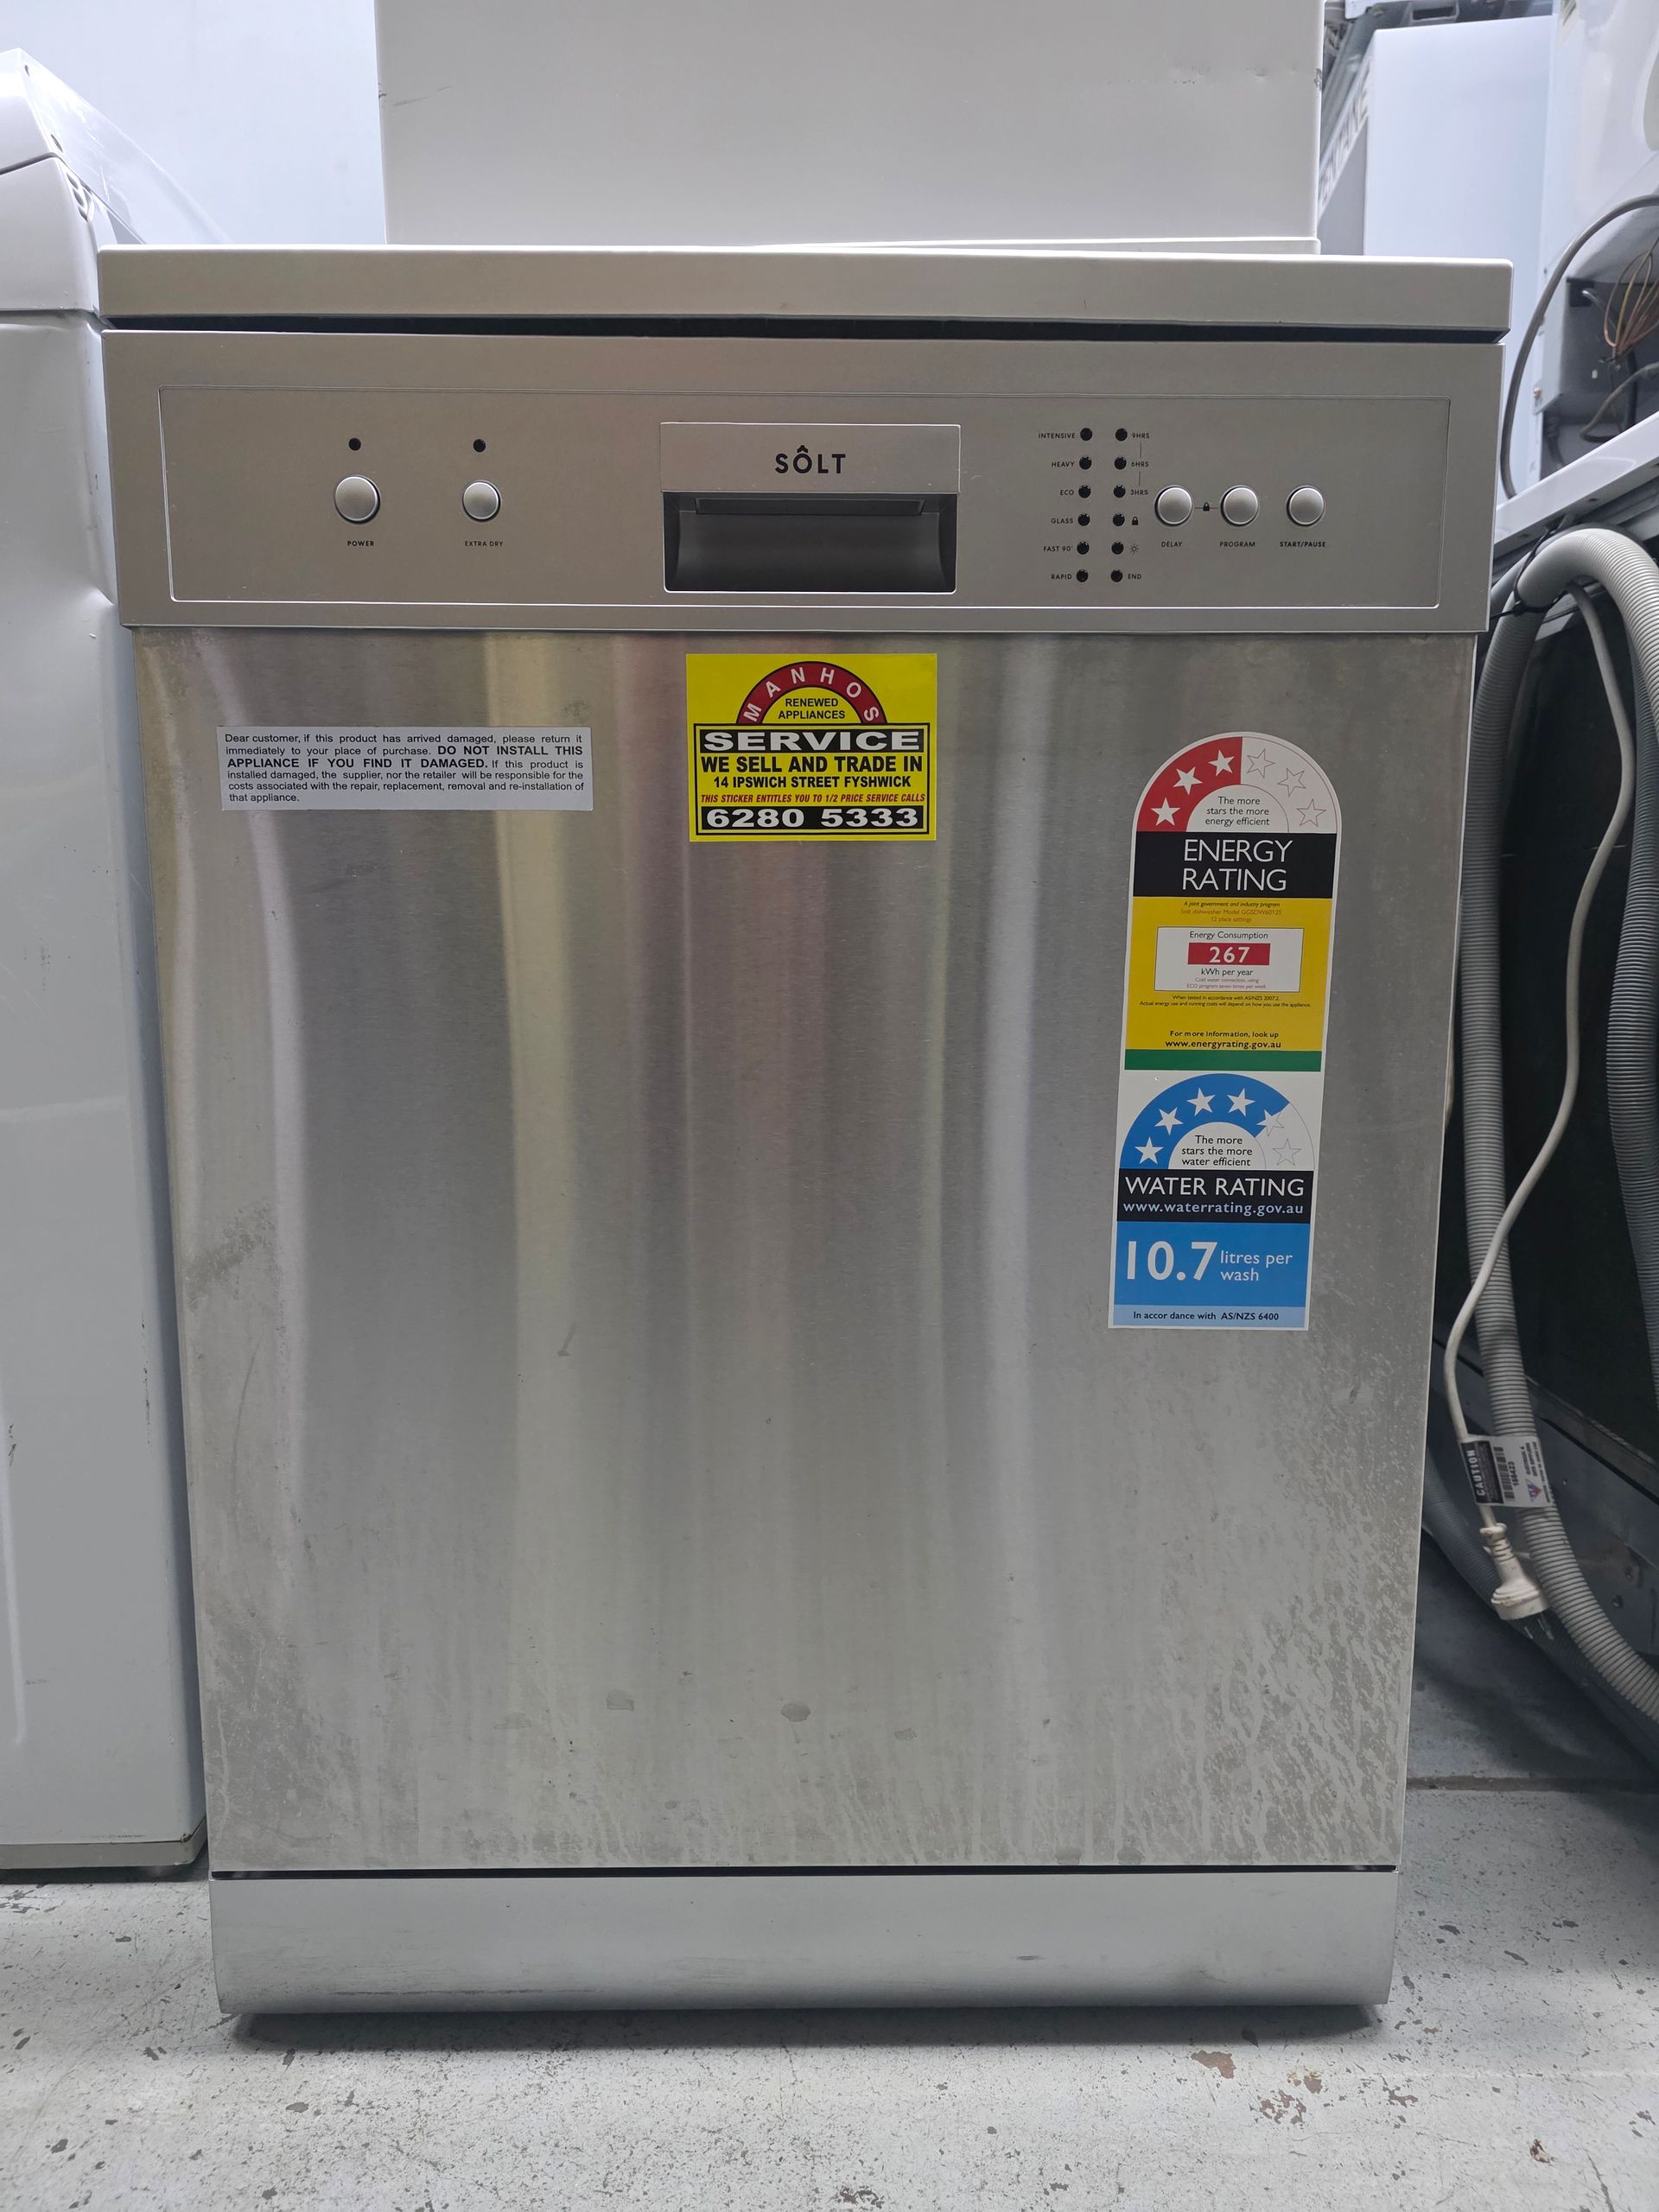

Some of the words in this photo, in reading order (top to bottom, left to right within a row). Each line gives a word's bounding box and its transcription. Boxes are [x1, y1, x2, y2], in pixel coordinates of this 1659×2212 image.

[775, 445, 846, 474] SÔLT
[743, 667, 880, 722] MANHOS
[785, 698, 838, 707] RENEWED
[778, 710, 845, 719] APPLIANCES
[225, 734, 250, 742] Dear
[252, 734, 301, 743] customer,
[303, 734, 310, 742] if
[315, 734, 334, 743] this
[340, 734, 377, 744] product
[383, 734, 401, 743] has
[407, 734, 441, 743] arrived
[447, 734, 496, 745] damaged,
[503, 734, 535, 745] please
[576, 734, 582, 743] it
[704, 731, 919, 751] SERVICE
[226, 747, 285, 756] immediately
[334, 747, 361, 756] place
[367, 747, 377, 755] of
[383, 747, 430, 757] purchase.
[437, 746, 456, 755] DO
[463, 746, 490, 755] NOT
[497, 746, 549, 755] INSTALL
[555, 746, 582, 755] THIS
[227, 758, 299, 768] APPLIANCE
[308, 758, 319, 767] IF
[327, 758, 354, 768] YOU
[363, 758, 392, 768] FIND
[401, 759, 412, 768] IT
[421, 759, 487, 768] DAMAGED.
[492, 760, 499, 768] If
[530, 760, 568, 770] product
[701, 756, 729, 772] WE
[736, 755, 782, 772] SELL
[788, 756, 828, 772] AND
[834, 755, 896, 772] TRADE
[904, 755, 922, 772] IN
[227, 770, 267, 779] installed
[270, 770, 319, 781] damaged,
[342, 771, 383, 781] supplier,
[404, 771, 420, 779] the
[423, 771, 456, 779] retailer
[461, 771, 477, 779] will
[480, 771, 493, 779] be
[495, 771, 550, 781] responsible
[552, 771, 566, 779] for
[569, 771, 583, 779] the
[257, 782, 308, 791] associated
[310, 781, 330, 790] with
[350, 781, 380, 791] repair,
[383, 782, 444, 791] replacement,
[448, 782, 486, 791] removal
[488, 782, 506, 791] and
[509, 782, 572, 791] re-installation
[575, 782, 584, 791] of
[714, 776, 728, 788] 14
[733, 776, 786, 788] IPSWICH
[791, 776, 840, 788] STREET
[844, 775, 912, 788] FYSHWICK
[229, 793, 248, 802] that
[251, 793, 300, 804] appliance.
[701, 794, 718, 803] THIS
[721, 794, 753, 803] STICKER
[756, 794, 792, 803] ENTITLES
[795, 794, 810, 803] YOU
[813, 794, 823, 803] TO
[825, 794, 838, 803] 1/2
[866, 793, 899, 802] SERVICE
[901, 793, 925, 802] CALLS
[1217, 796, 1235, 804] The
[1230, 806, 1243, 815] the
[707, 808, 804, 828] 6280
[821, 808, 918, 827] 5333
[1205, 818, 1234, 828] energy
[1236, 817, 1270, 826] efficient
[1184, 839, 1293, 862] ENERGY
[1182, 868, 1287, 891] RATING
[1189, 931, 1216, 941] Energy
[1217, 931, 1268, 941] Consumption
[1209, 946, 1250, 963] 267
[1165, 1039, 1281, 1050] www.energyrating.gov.au
[1194, 1135, 1214, 1144] The
[1208, 1146, 1224, 1155] the
[1213, 1157, 1251, 1166] efficient
[1125, 1177, 1206, 1195] WATER
[1216, 1178, 1304, 1196] RATING
[1122, 1201, 1303, 1217] www.waterrating.gov.au
[1127, 1241, 1217, 1281] 10.7
[1220, 1249, 1260, 1264] litres
[1266, 1255, 1293, 1268] per
[1220, 1268, 1259, 1281] wash
[1221, 1312, 1255, 1320] AS/NZS
[1465, 1449, 1486, 1497] CAUTION
